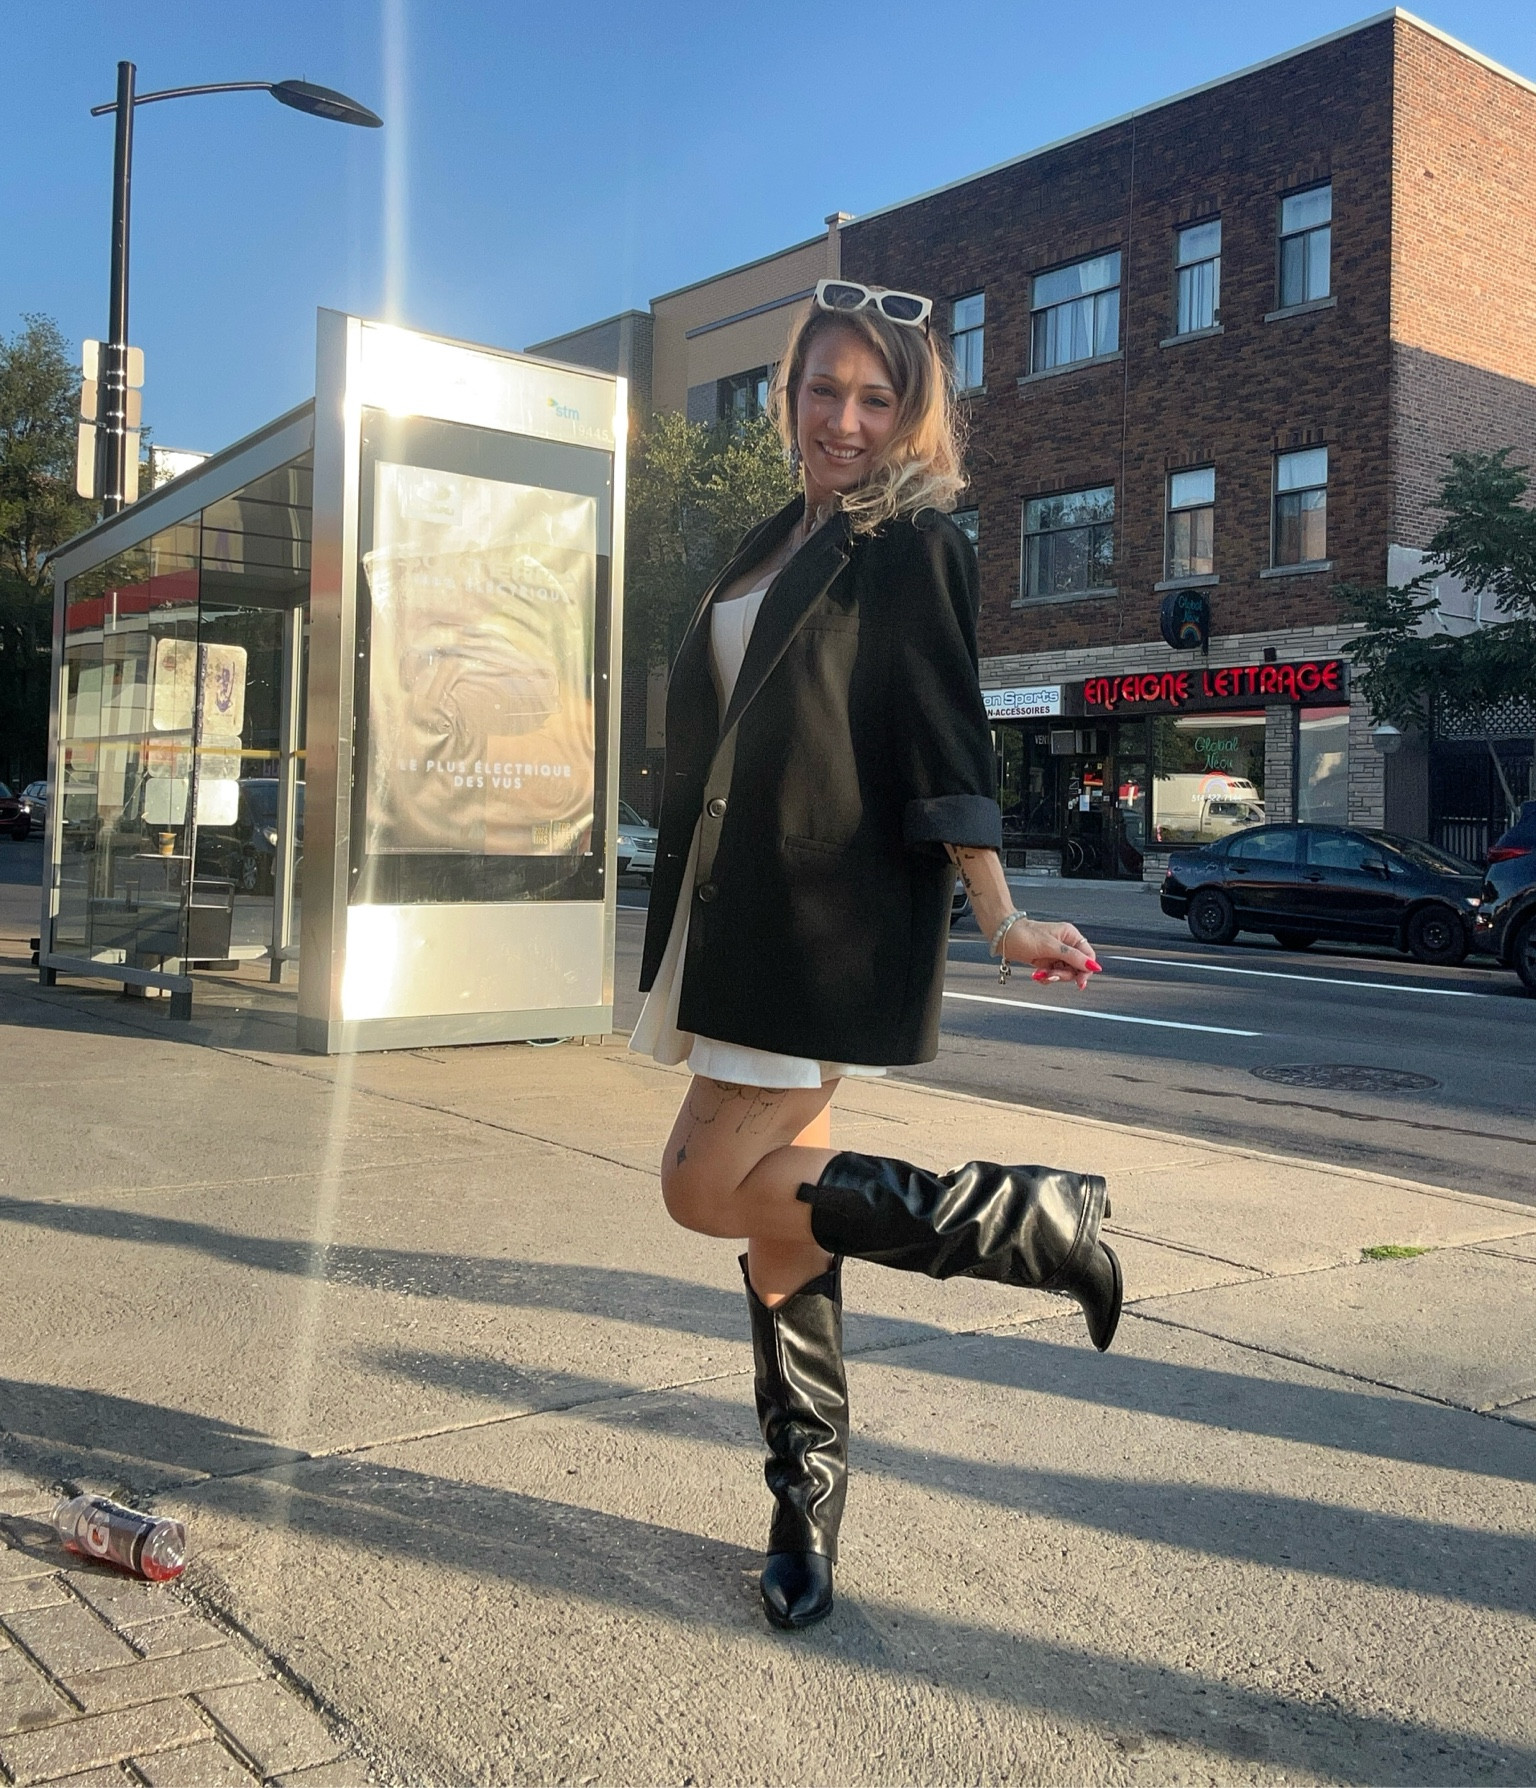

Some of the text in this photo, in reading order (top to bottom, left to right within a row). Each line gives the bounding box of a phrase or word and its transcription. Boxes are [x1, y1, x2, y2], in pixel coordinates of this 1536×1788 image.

[556, 404, 580, 420] stm
[1084, 661, 1339, 710] ENSEIGNE LETTRAGE
[981, 690, 1059, 708] on Sports
[1195, 736, 1239, 752] Global
[399, 759, 572, 777] LE PLUS ÉLECTRIQUE
[454, 775, 522, 789] DES VUS
